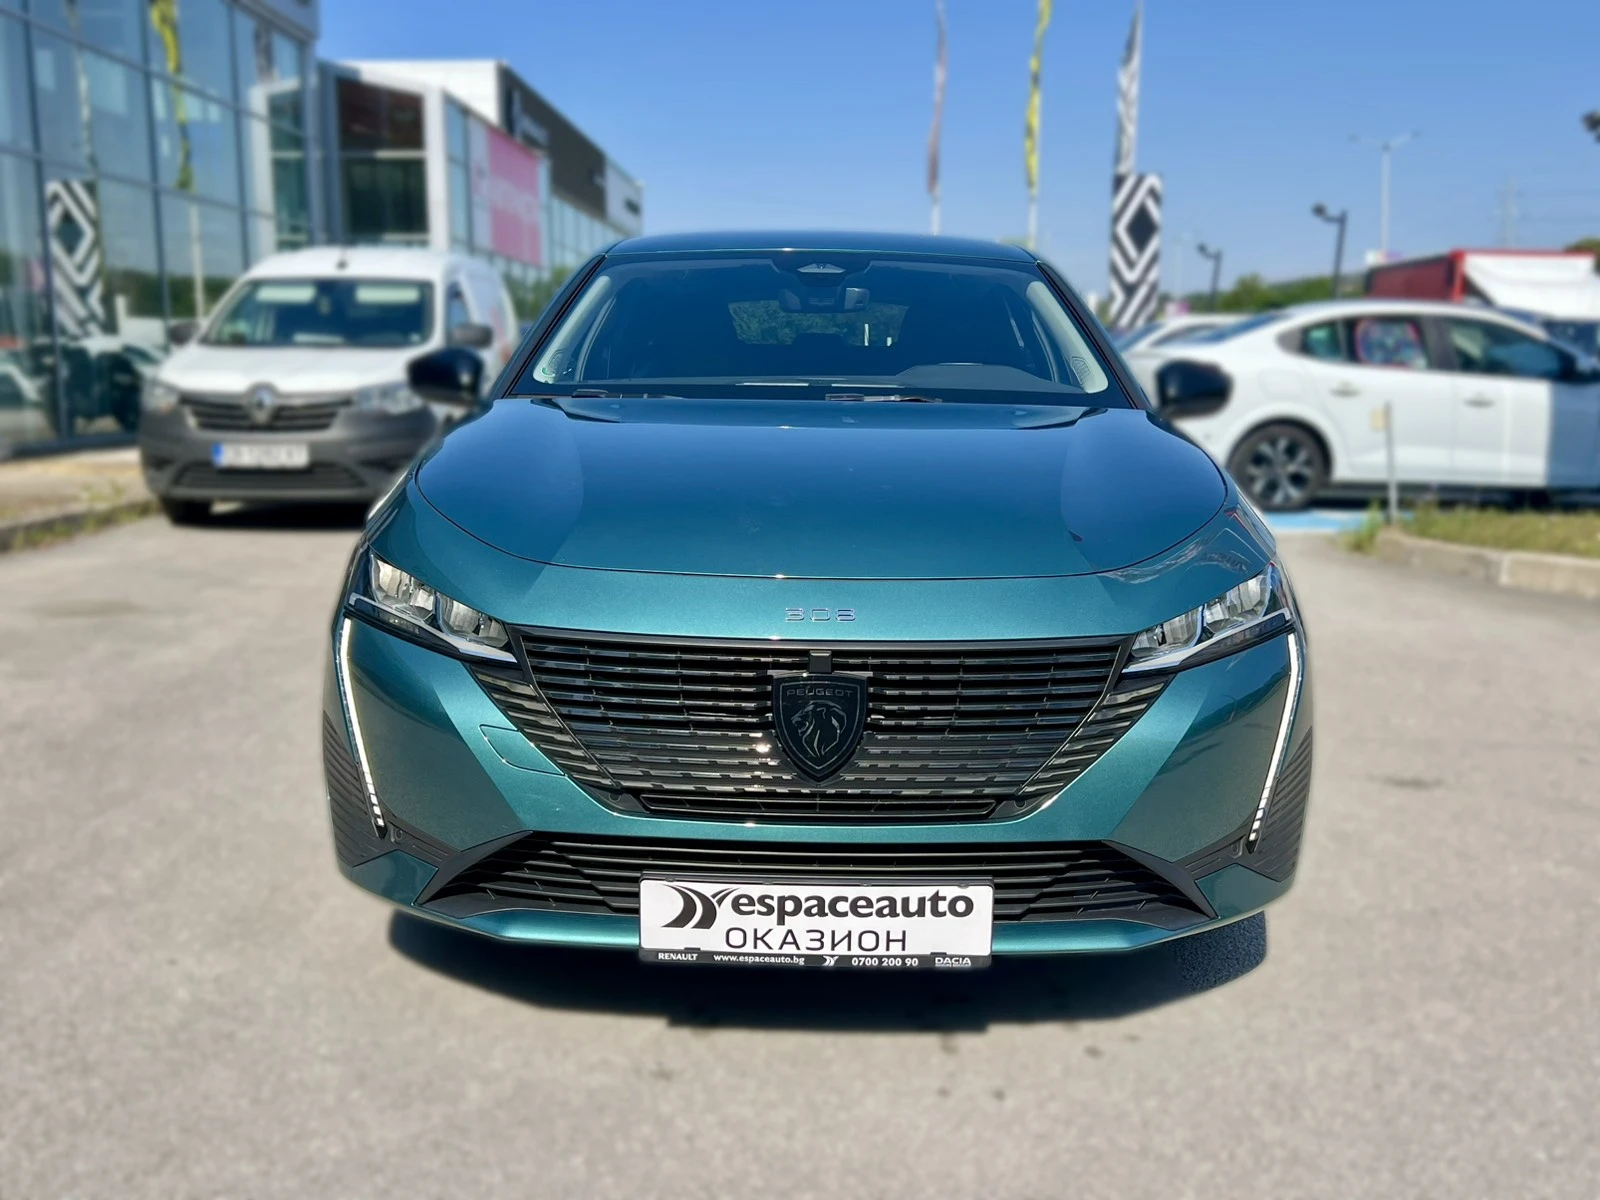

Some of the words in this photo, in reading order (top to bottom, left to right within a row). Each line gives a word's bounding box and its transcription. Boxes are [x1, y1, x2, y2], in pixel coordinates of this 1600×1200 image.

[785, 608, 856, 622] 308
[786, 688, 854, 696] PEUGEOT
[731, 889, 974, 926] espaceauto
[725, 927, 907, 952] ОКАЗИОН
[658, 952, 698, 961] RENAULT
[713, 954, 805, 965] www.espaceauto.bg
[935, 957, 972, 965] DACIA
[851, 957, 879, 967] 0700
[881, 958, 902, 967] 200
[904, 958, 919, 967] 90
